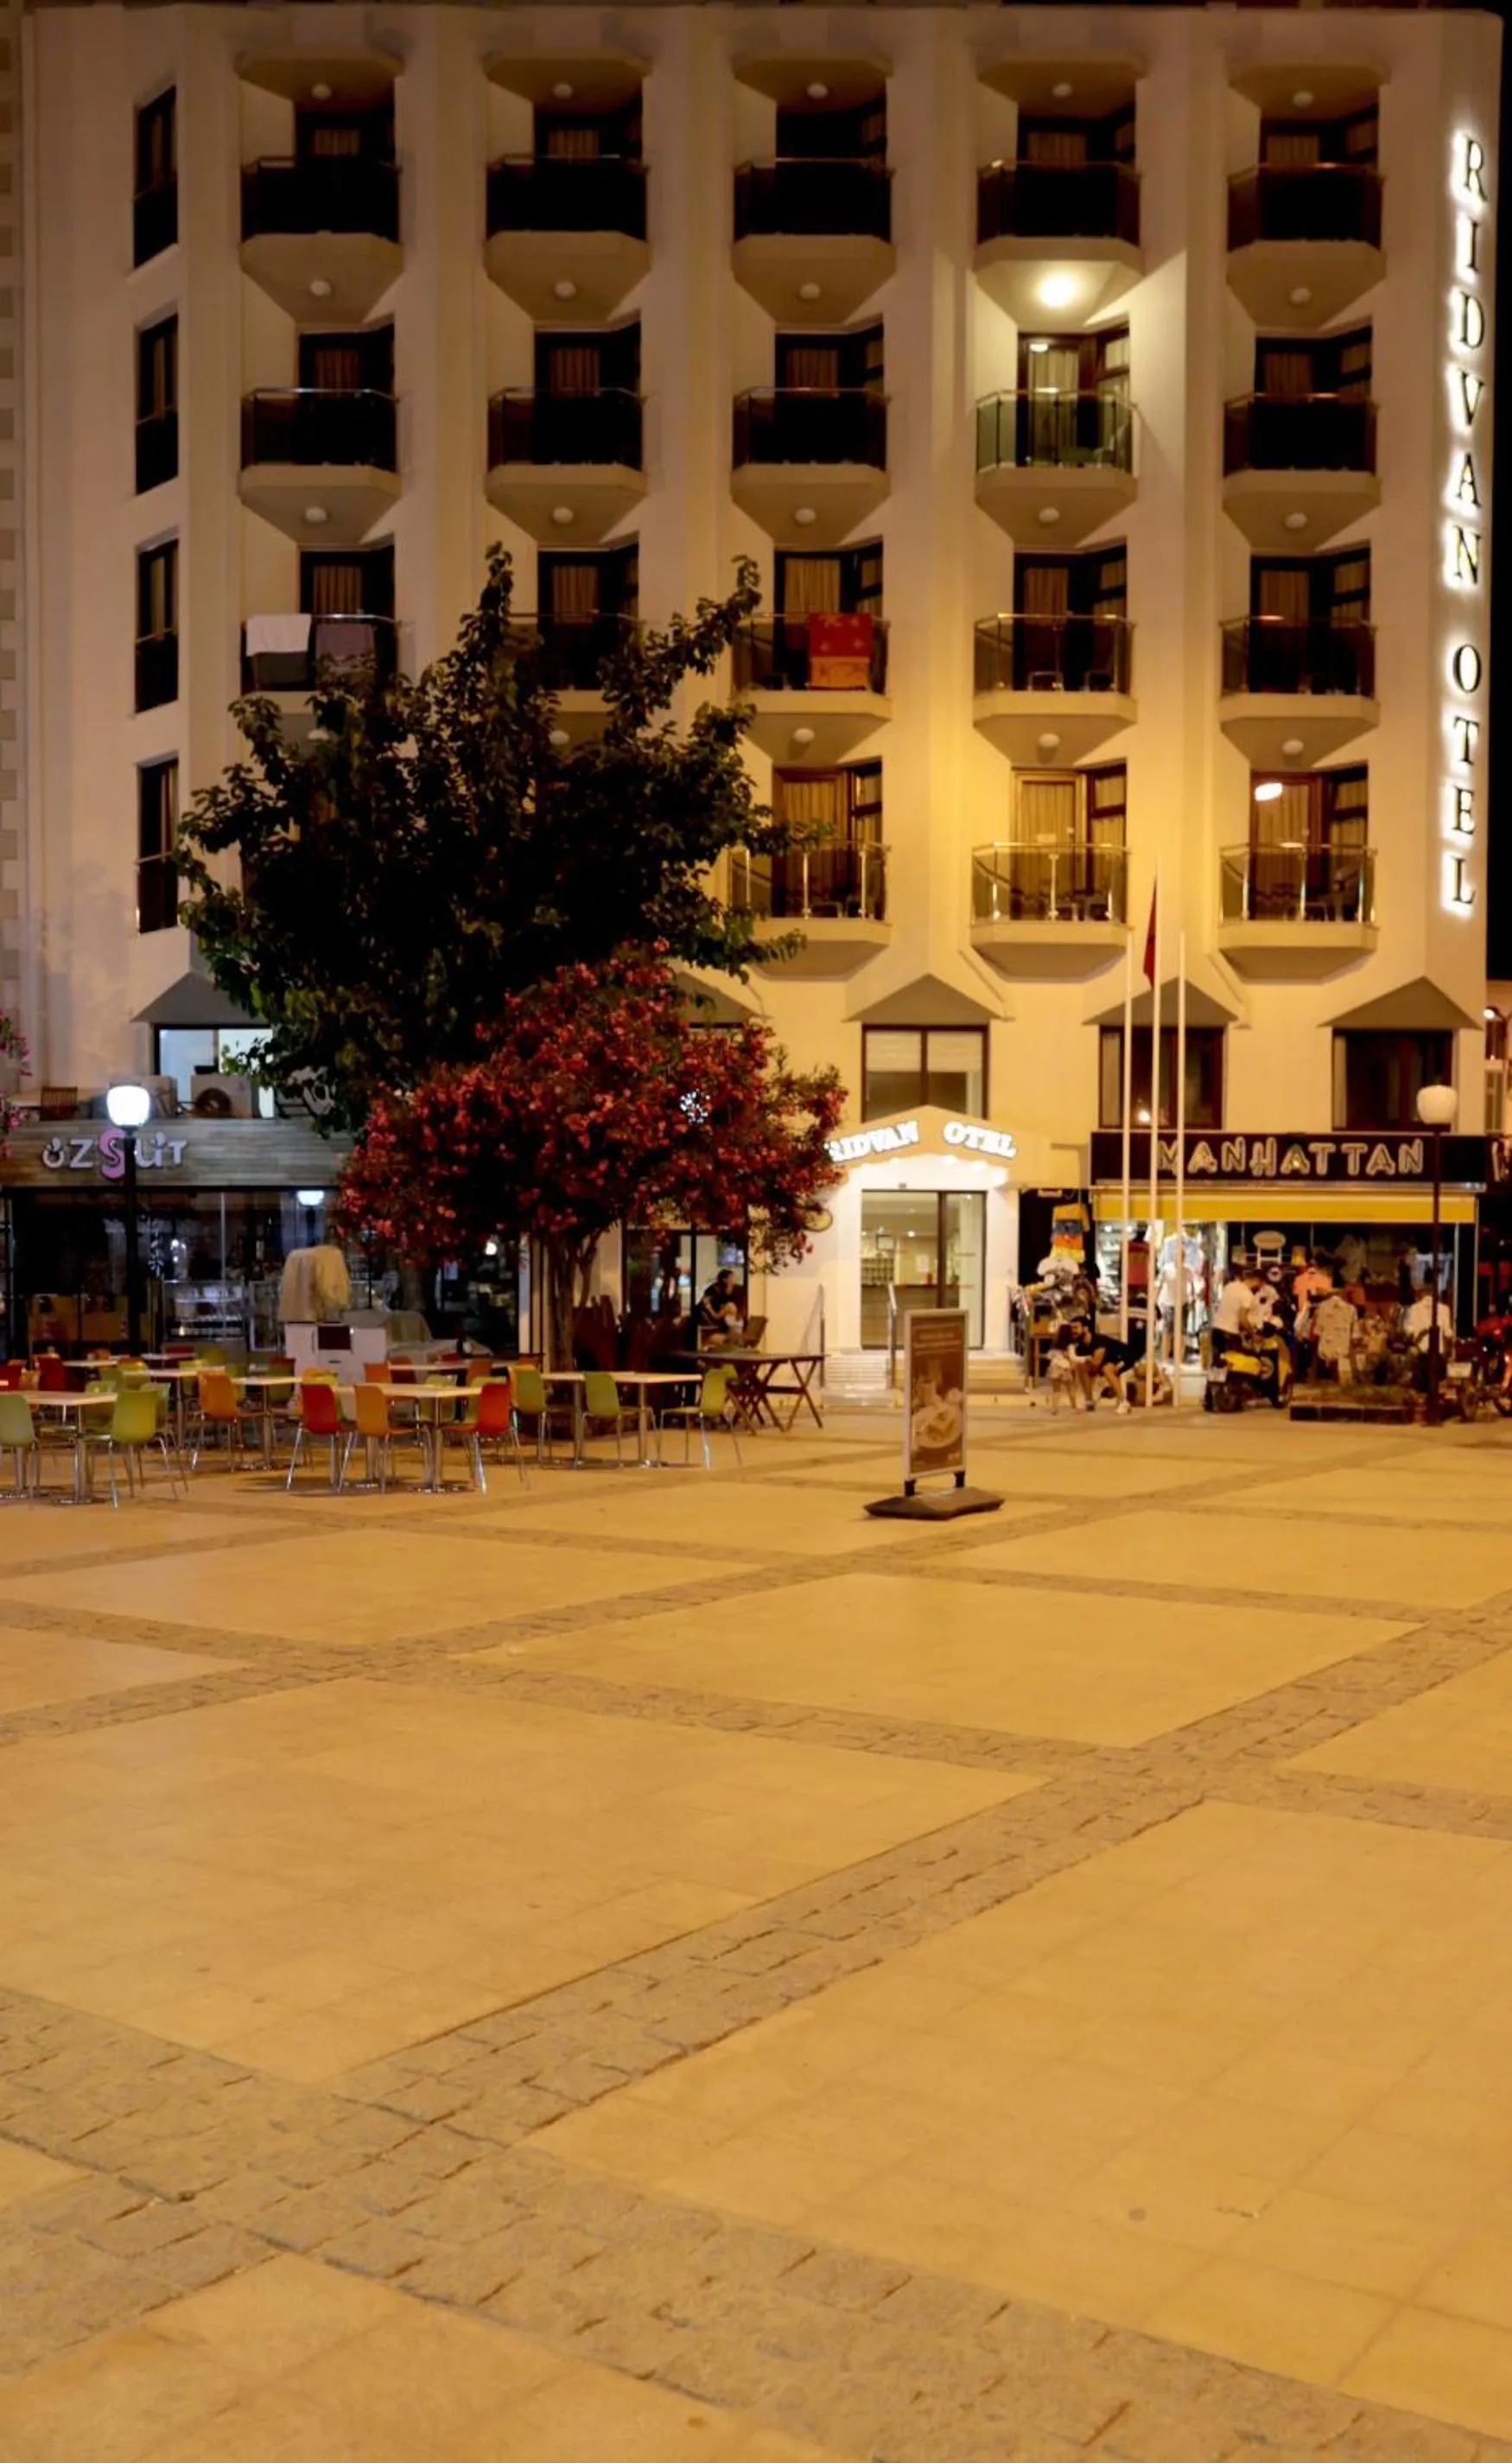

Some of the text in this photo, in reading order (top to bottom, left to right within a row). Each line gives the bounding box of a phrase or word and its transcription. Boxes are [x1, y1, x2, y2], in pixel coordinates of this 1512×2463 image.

[1452, 138, 1488, 906] RIDVAN OTEL
[1157, 1136, 1423, 1176] MANHATTAN
